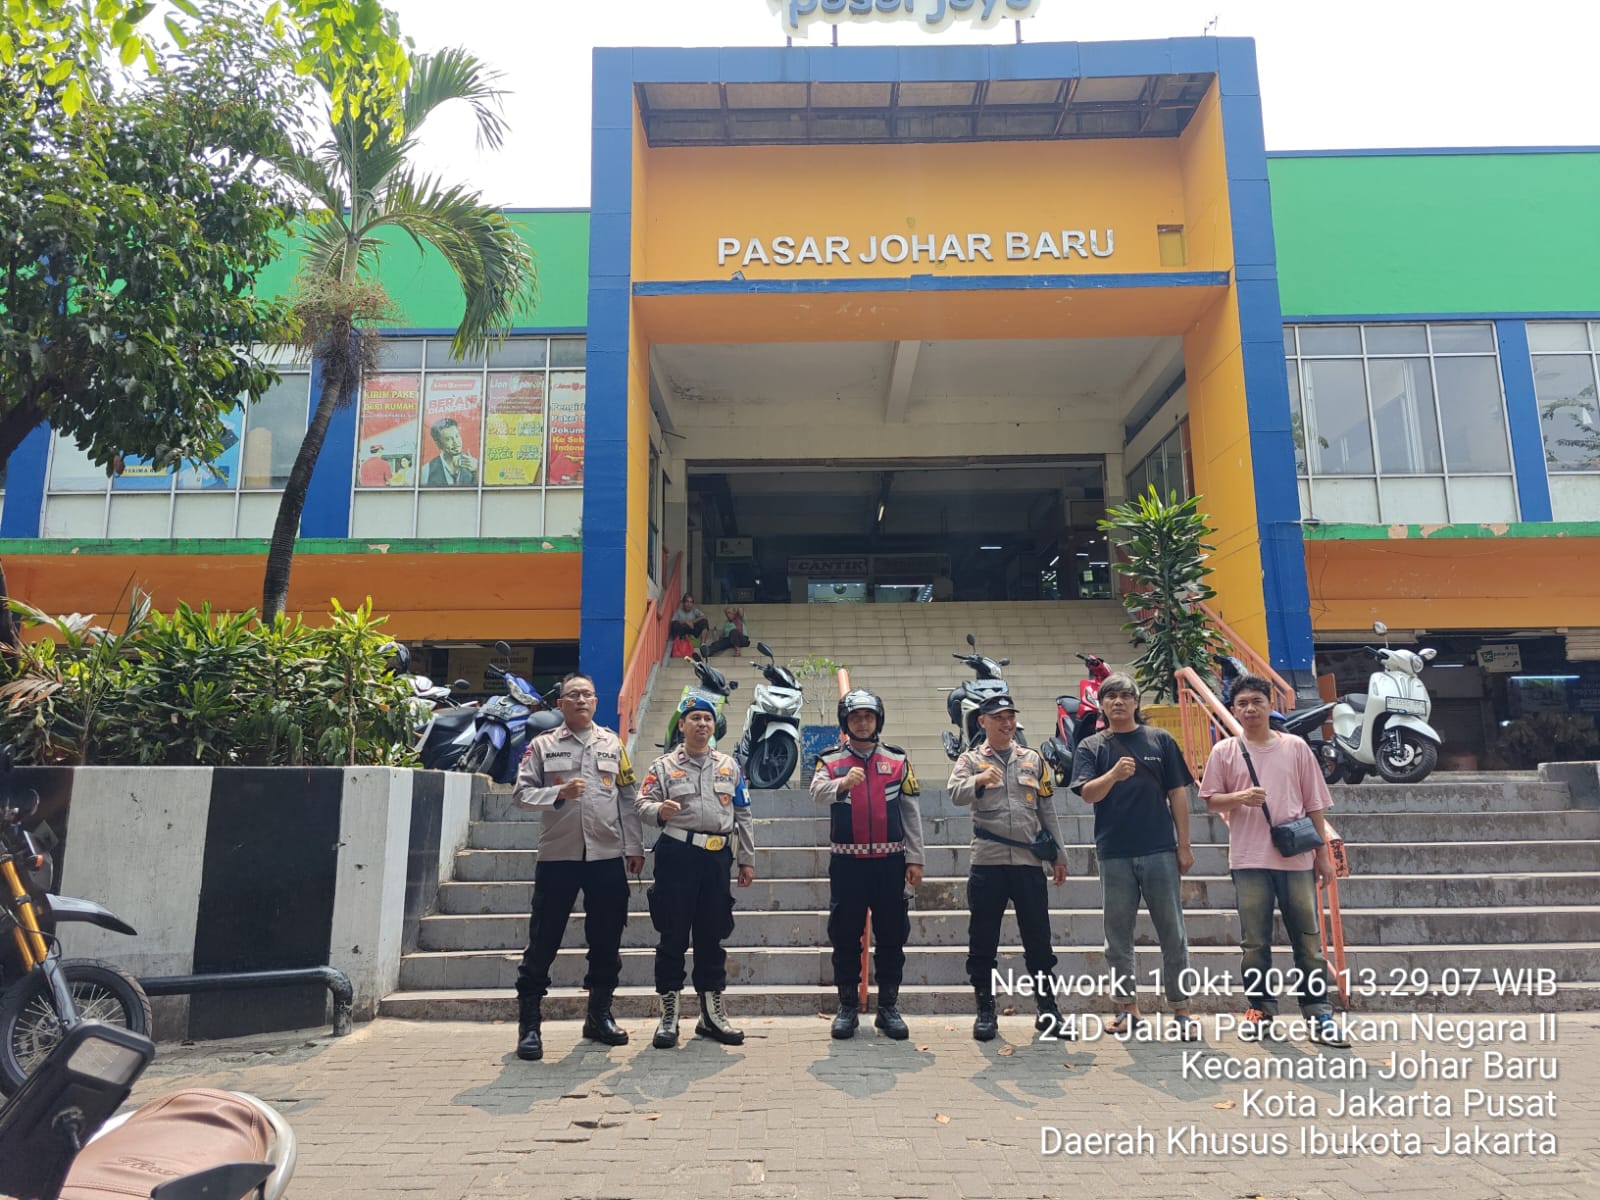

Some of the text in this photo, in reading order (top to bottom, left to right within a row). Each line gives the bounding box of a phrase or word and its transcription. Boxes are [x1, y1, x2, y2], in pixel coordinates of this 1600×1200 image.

[718, 229, 1114, 265] PASAR JOHAR BARU
